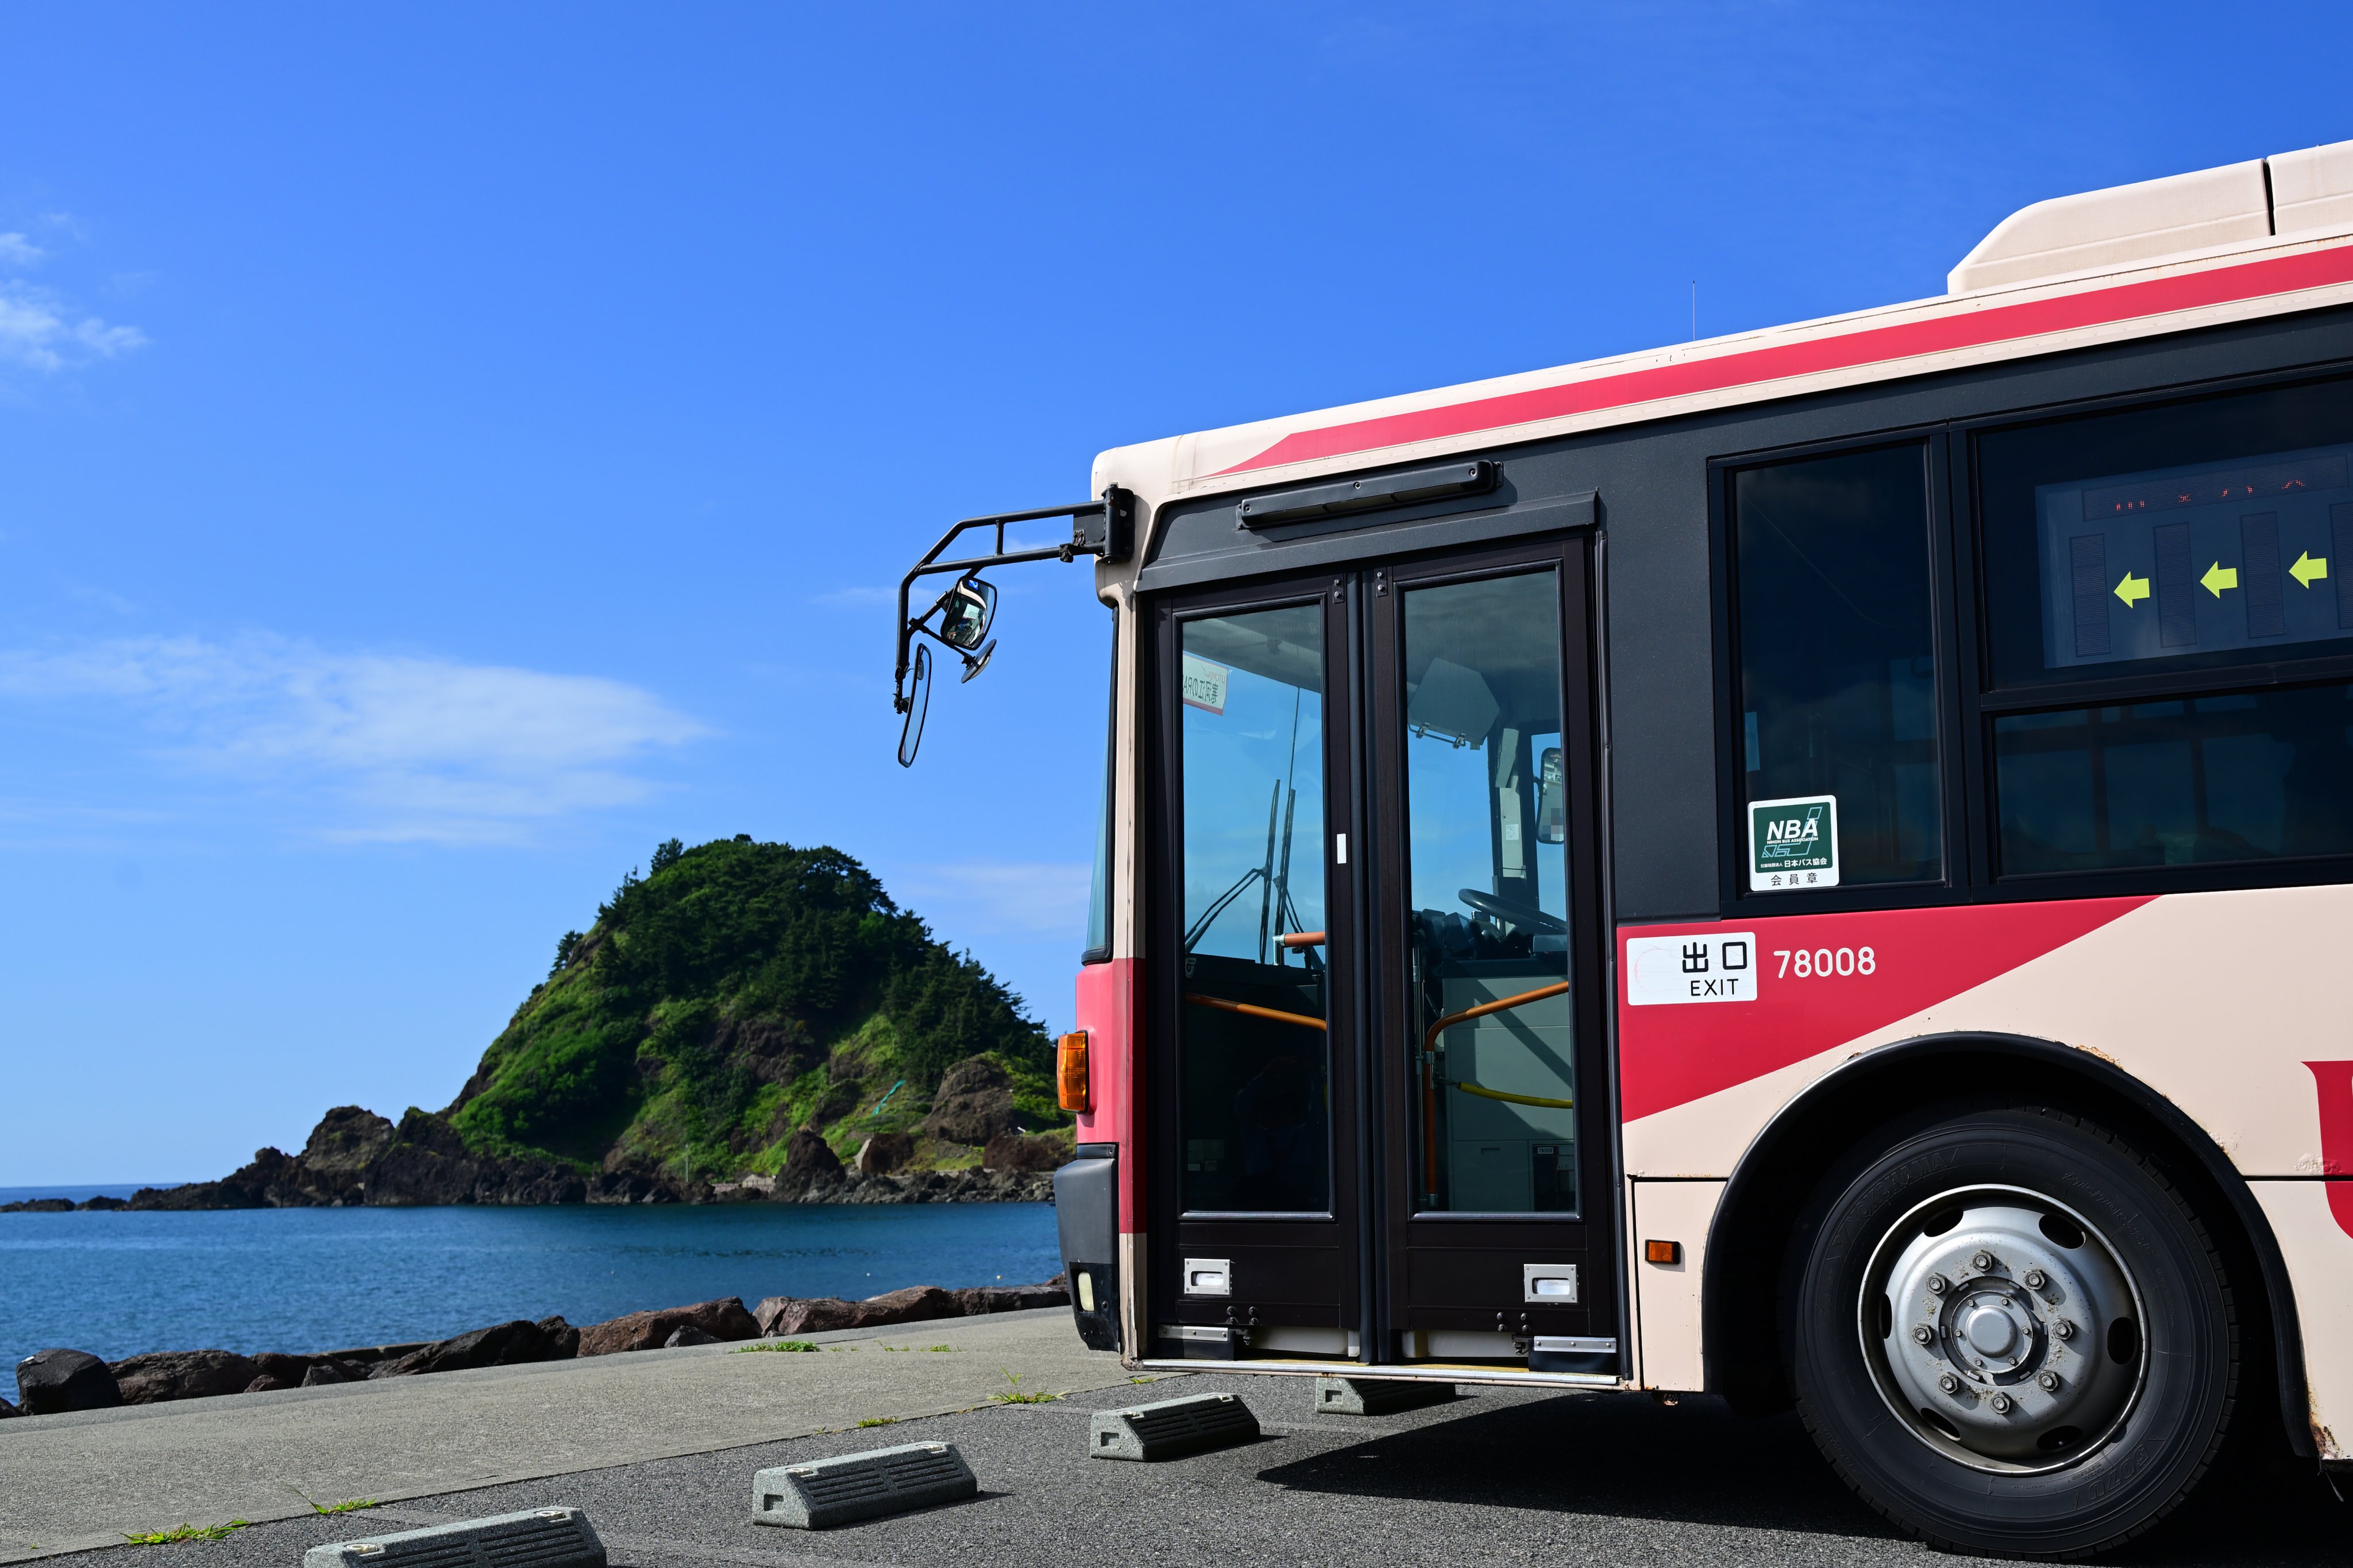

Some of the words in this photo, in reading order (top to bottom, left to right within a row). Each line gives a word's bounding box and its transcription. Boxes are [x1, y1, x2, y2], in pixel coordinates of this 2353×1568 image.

[1766, 818, 1818, 840] NBA
[1784, 858, 1827, 868] 日本バス協会
[1771, 872, 1818, 886] 会員章
[1682, 941, 1748, 973] 出口
[1773, 946, 1876, 979] 78008
[1691, 978, 1739, 997] EXIT
[1844, 1152, 1949, 1227] YOKOHAMA
[2089, 1445, 2150, 1500] 507U
